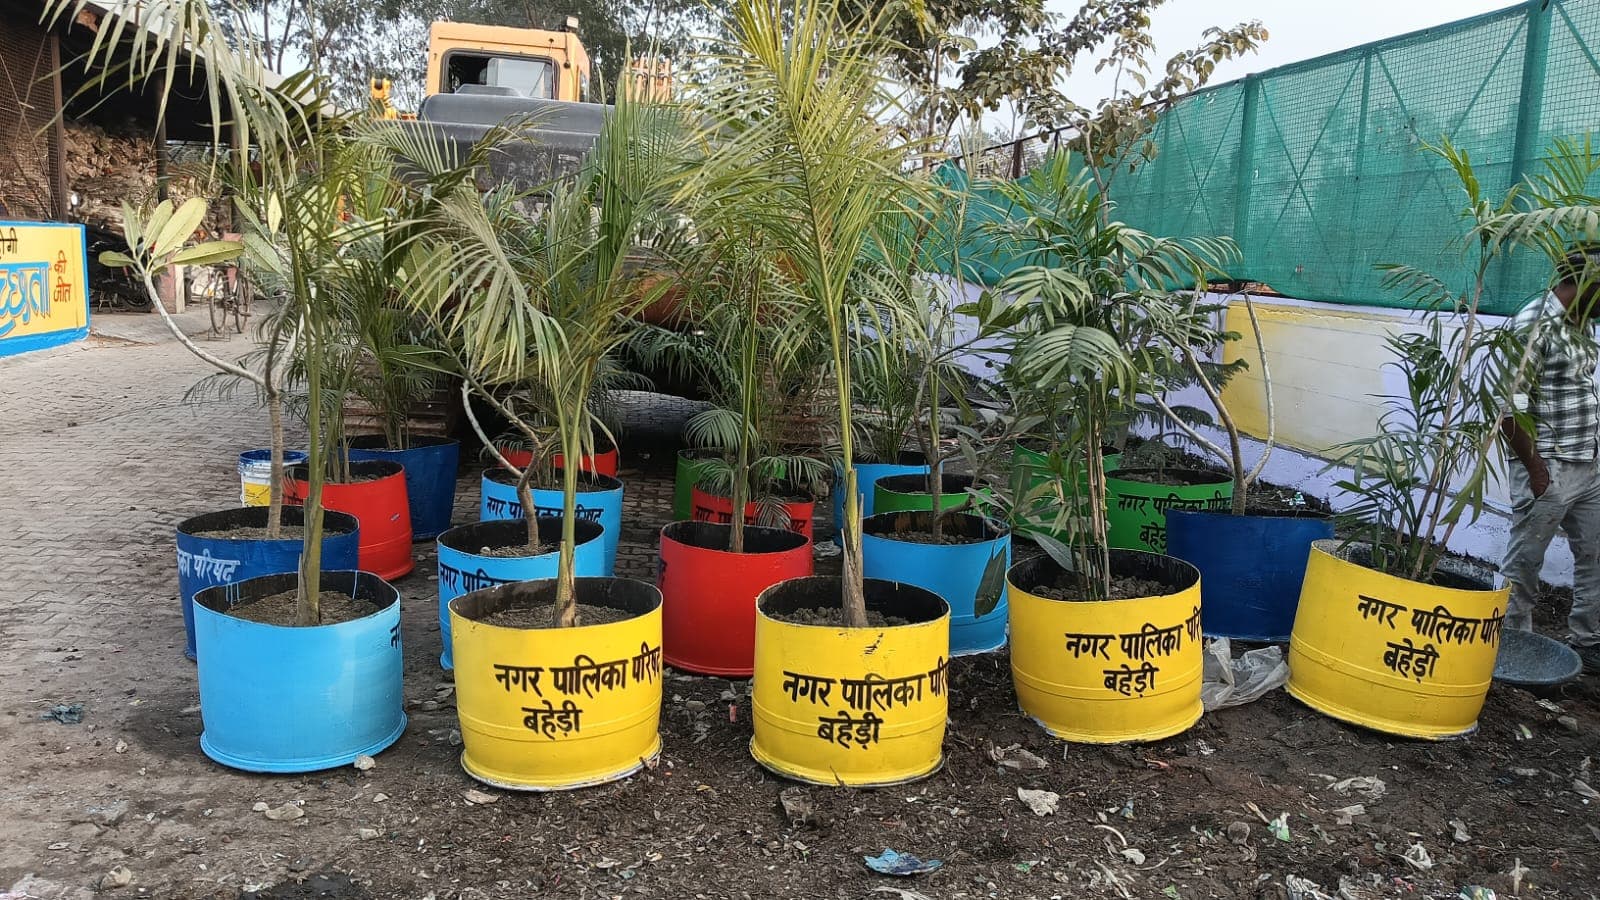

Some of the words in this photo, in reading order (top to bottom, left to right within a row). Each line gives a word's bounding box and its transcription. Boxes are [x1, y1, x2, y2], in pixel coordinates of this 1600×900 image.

[54, 250, 67, 275] की
[53, 276, 72, 303] जीत
[486, 496, 506, 519] नगर
[1118, 493, 1150, 516] नगर
[440, 562, 460, 595] नगर
[1065, 633, 1116, 660] नगर
[1119, 623, 1183, 661] पालिका
[1185, 605, 1202, 642] परि
[1357, 594, 1407, 630] नगर
[1411, 605, 1481, 645] पालिका
[493, 664, 544, 697] नगर
[550, 654, 629, 698] पालिका
[1103, 661, 1159, 698] बहेड़ी
[1383, 638, 1440, 683] बहेड़ी
[783, 670, 837, 707] नगर
[840, 672, 927, 711] पालिका
[928, 655, 949, 697] परि
[521, 699, 583, 740] बहेड़ी
[817, 710, 883, 750] बहेड़ी
